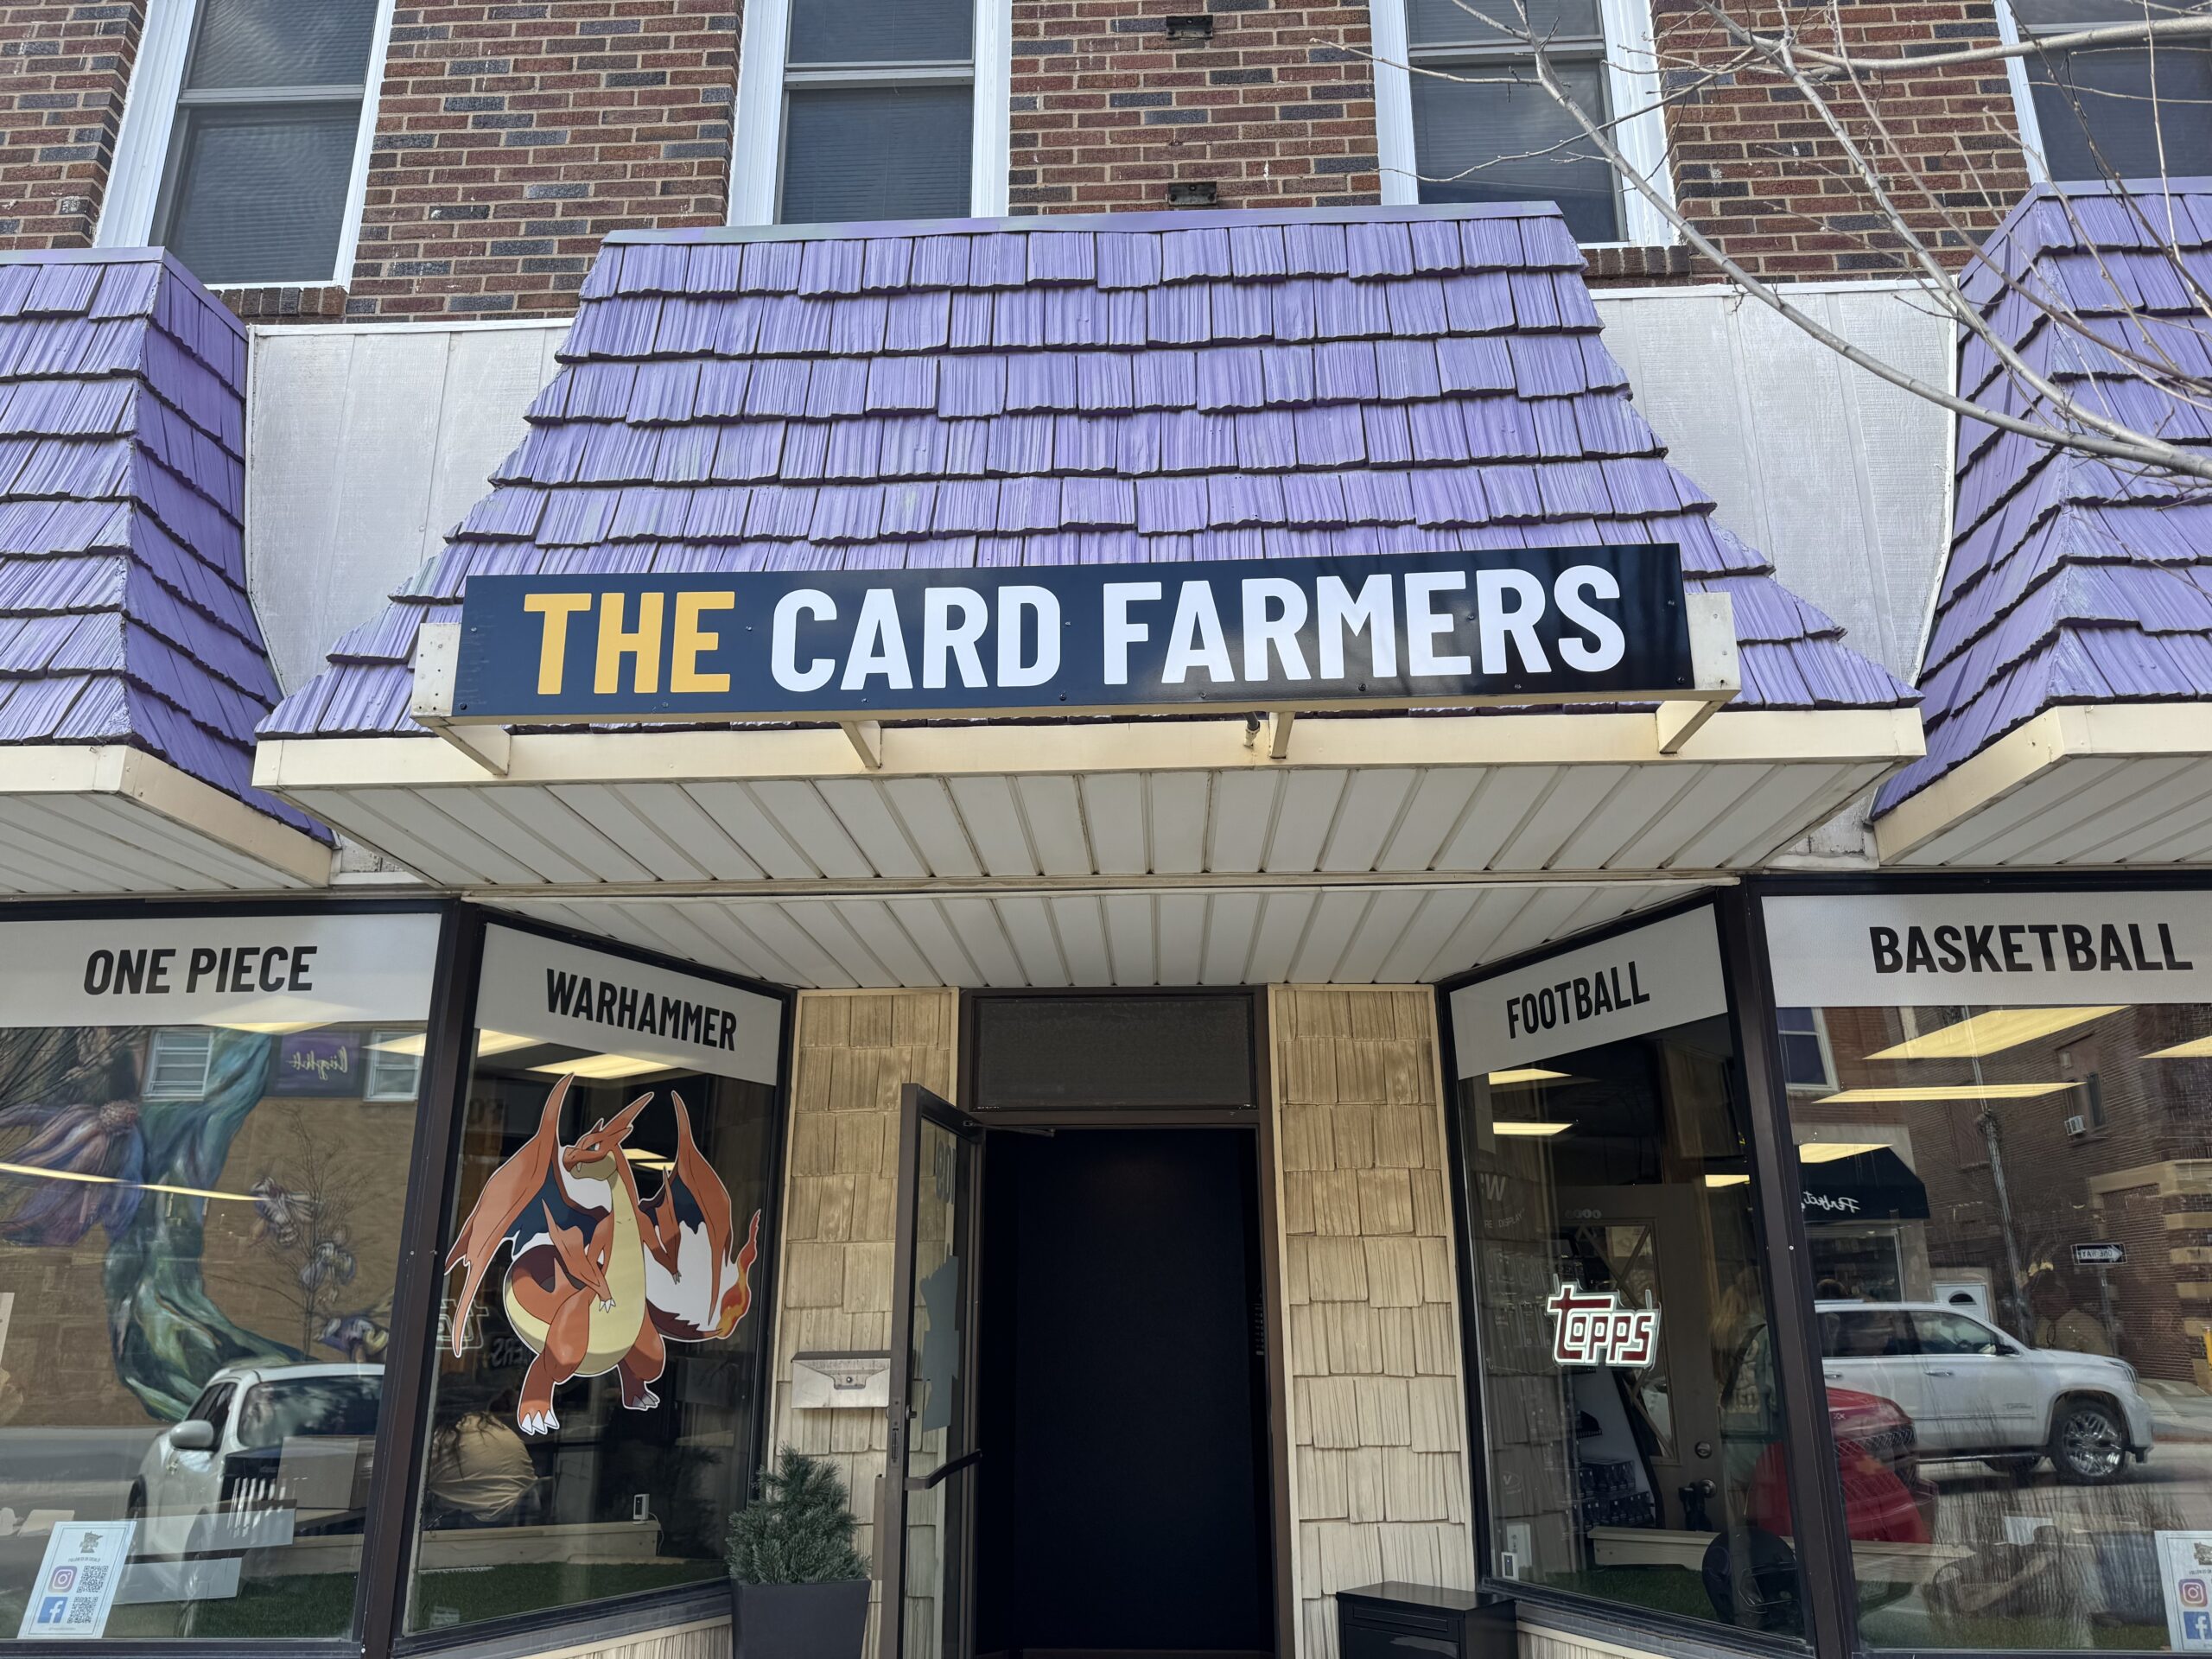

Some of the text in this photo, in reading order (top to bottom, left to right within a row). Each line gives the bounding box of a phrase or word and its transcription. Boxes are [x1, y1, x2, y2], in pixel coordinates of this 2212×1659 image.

[524, 564, 1625, 695] THE CARD FARMERS
[84, 946, 318, 995] ONE PIECE
[1869, 923, 2194, 974] BASKETBALL
[546, 968, 737, 1052] WARHAMMER
[1506, 961, 1650, 1039] FOOTBALL
